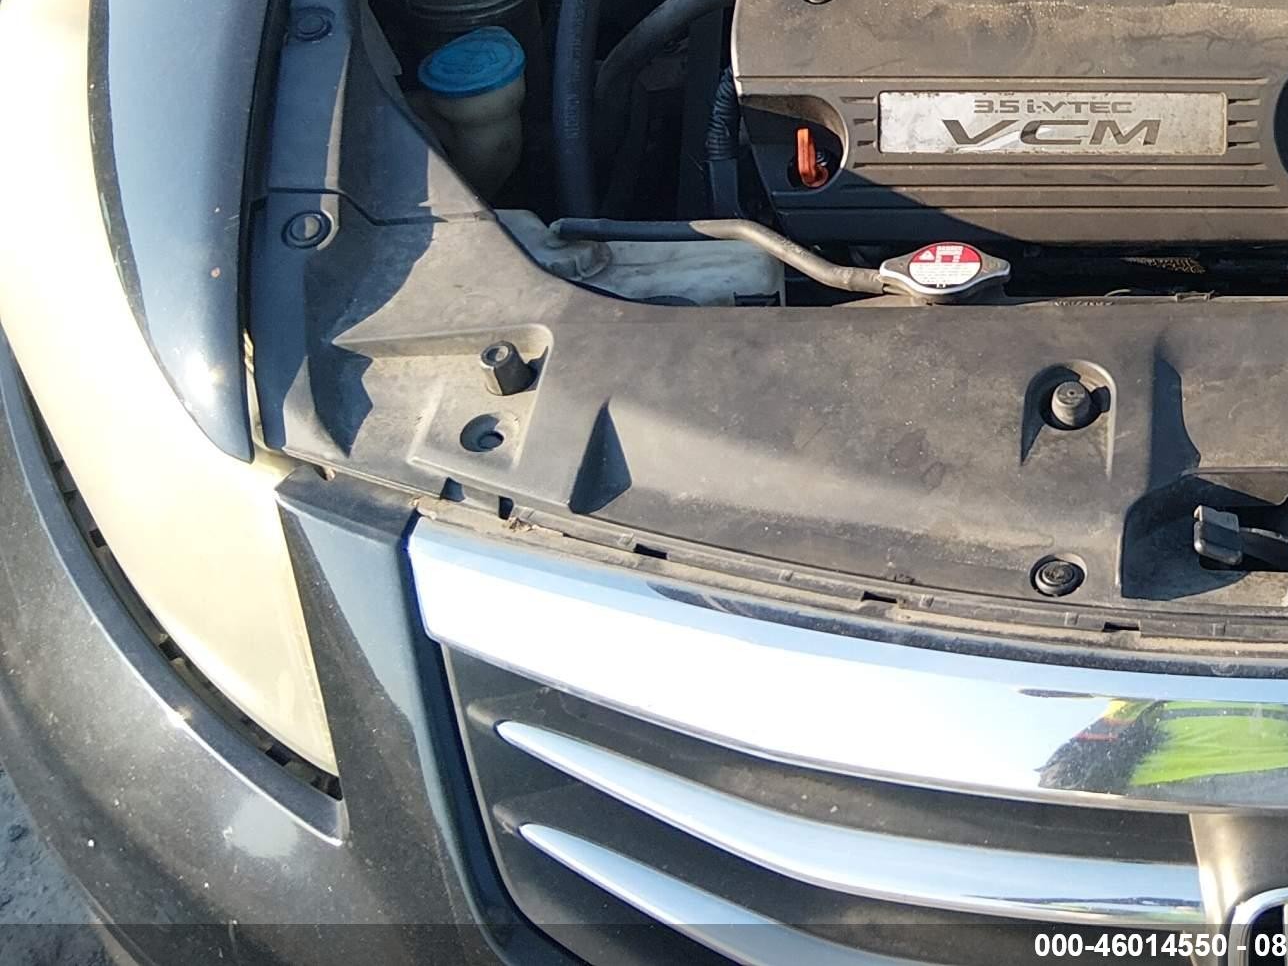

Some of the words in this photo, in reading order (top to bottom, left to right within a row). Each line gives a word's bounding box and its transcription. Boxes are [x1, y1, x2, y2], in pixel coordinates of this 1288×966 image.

[973, 99, 1023, 115] 3.5
[1027, 99, 1134, 115] i-VTEC
[941, 119, 1162, 147] VCM
